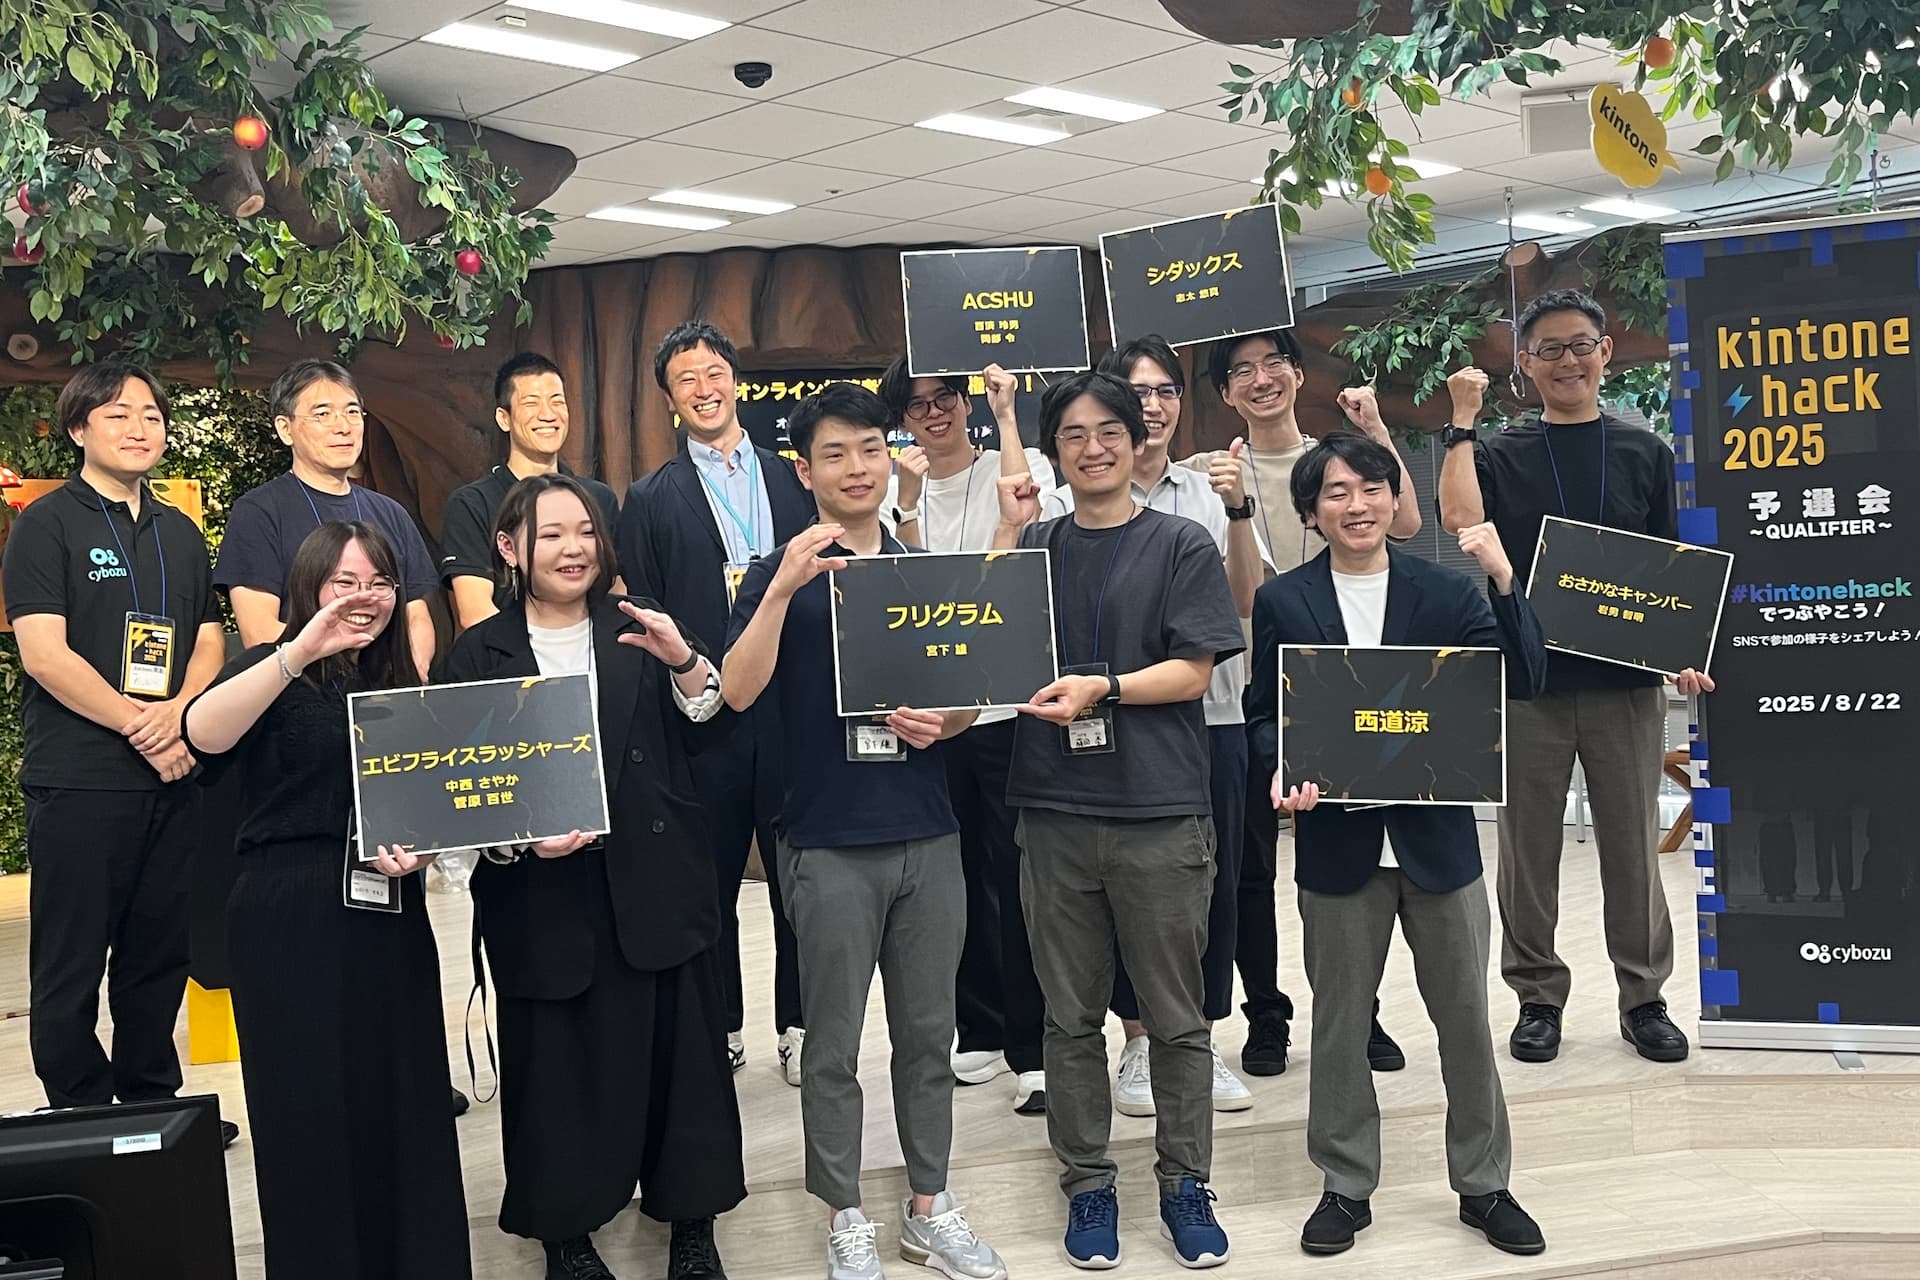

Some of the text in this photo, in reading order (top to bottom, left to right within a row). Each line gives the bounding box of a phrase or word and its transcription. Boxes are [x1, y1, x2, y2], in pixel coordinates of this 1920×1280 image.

[1599, 96, 1658, 168] kintone
[1147, 253, 1243, 285] シダックス
[962, 290, 1034, 310] ACSHU
[1718, 317, 1910, 369] kintone
[1762, 367, 1882, 417] hack
[1723, 423, 1825, 470] 2025
[88, 566, 127, 582] cybozu
[1731, 577, 1912, 603] #kintonehack
[886, 602, 1004, 630] フリグラム
[1759, 602, 1885, 622] でつぶやこう！
[1354, 709, 1430, 733] 西道涼
[362, 733, 593, 776] エビフライスラッシャーズ
[478, 774, 519, 789] さやか
[486, 791, 514, 806] 百世
[1832, 944, 1892, 964] cybozu
